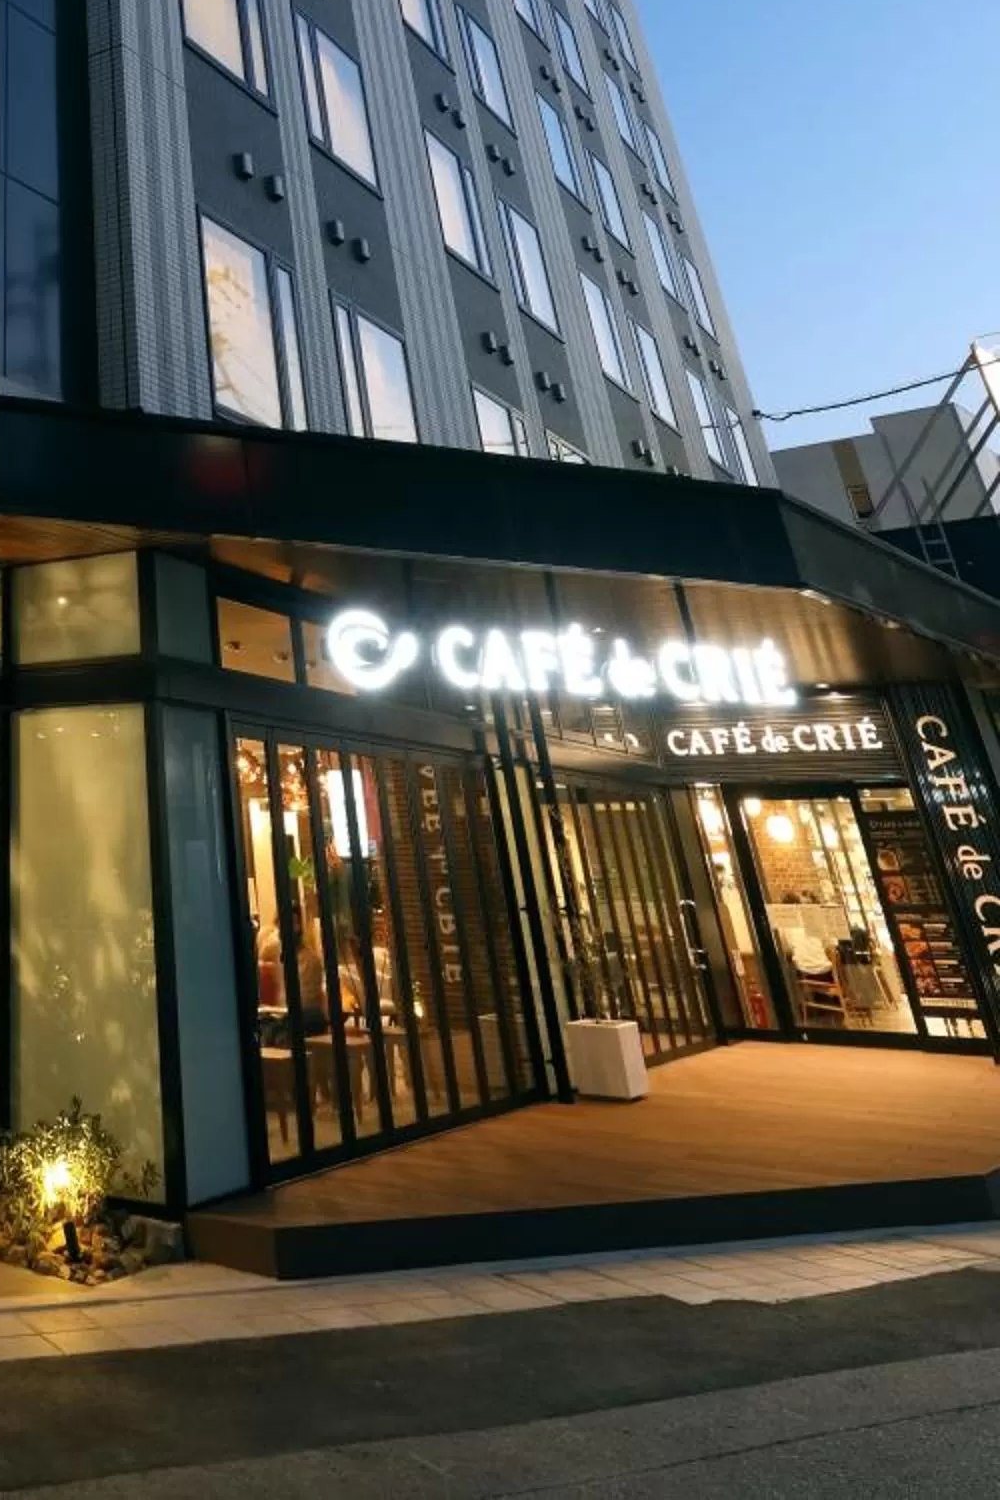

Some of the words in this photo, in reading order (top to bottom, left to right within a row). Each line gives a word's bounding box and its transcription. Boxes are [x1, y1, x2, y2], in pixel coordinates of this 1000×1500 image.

[436, 622, 601, 696] CAFÉ
[605, 639, 656, 698] de
[656, 637, 798, 706] CRIÉ
[667, 720, 756, 757] CAFÉ
[761, 726, 790, 753] de
[792, 716, 883, 751] CRIÉ
[916, 714, 987, 832] CAFÉ
[957, 844, 991, 881] de
[975, 894, 1000, 977] CR
